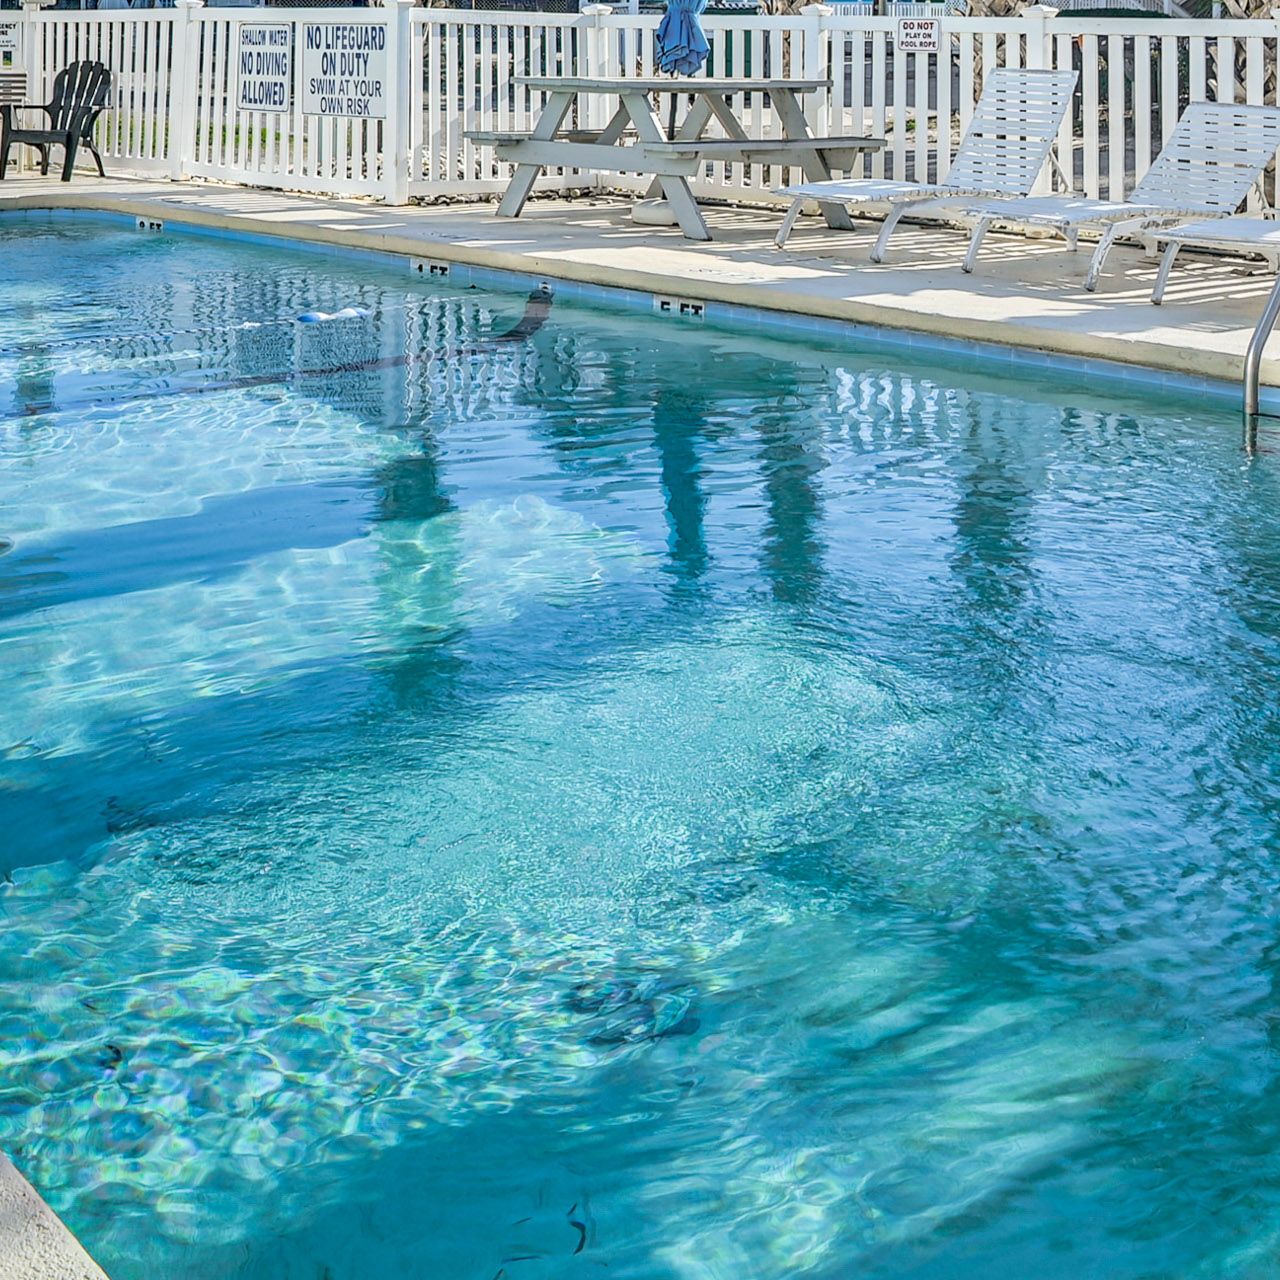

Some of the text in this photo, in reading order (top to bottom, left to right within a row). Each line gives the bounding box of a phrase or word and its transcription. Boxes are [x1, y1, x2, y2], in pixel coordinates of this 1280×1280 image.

[903, 22, 934, 30] DO NOT
[242, 30, 288, 46] SHALLOW WATER
[306, 26, 385, 51] NO LIFEGUARD
[900, 40, 917, 48] POOL
[241, 51, 287, 76] NO DIVING
[322, 52, 370, 77] ON DUTY
[242, 80, 285, 106] ALLOWED
[310, 78, 382, 98] SWIM AT YOUR
[320, 96, 370, 115] OWN RISK
